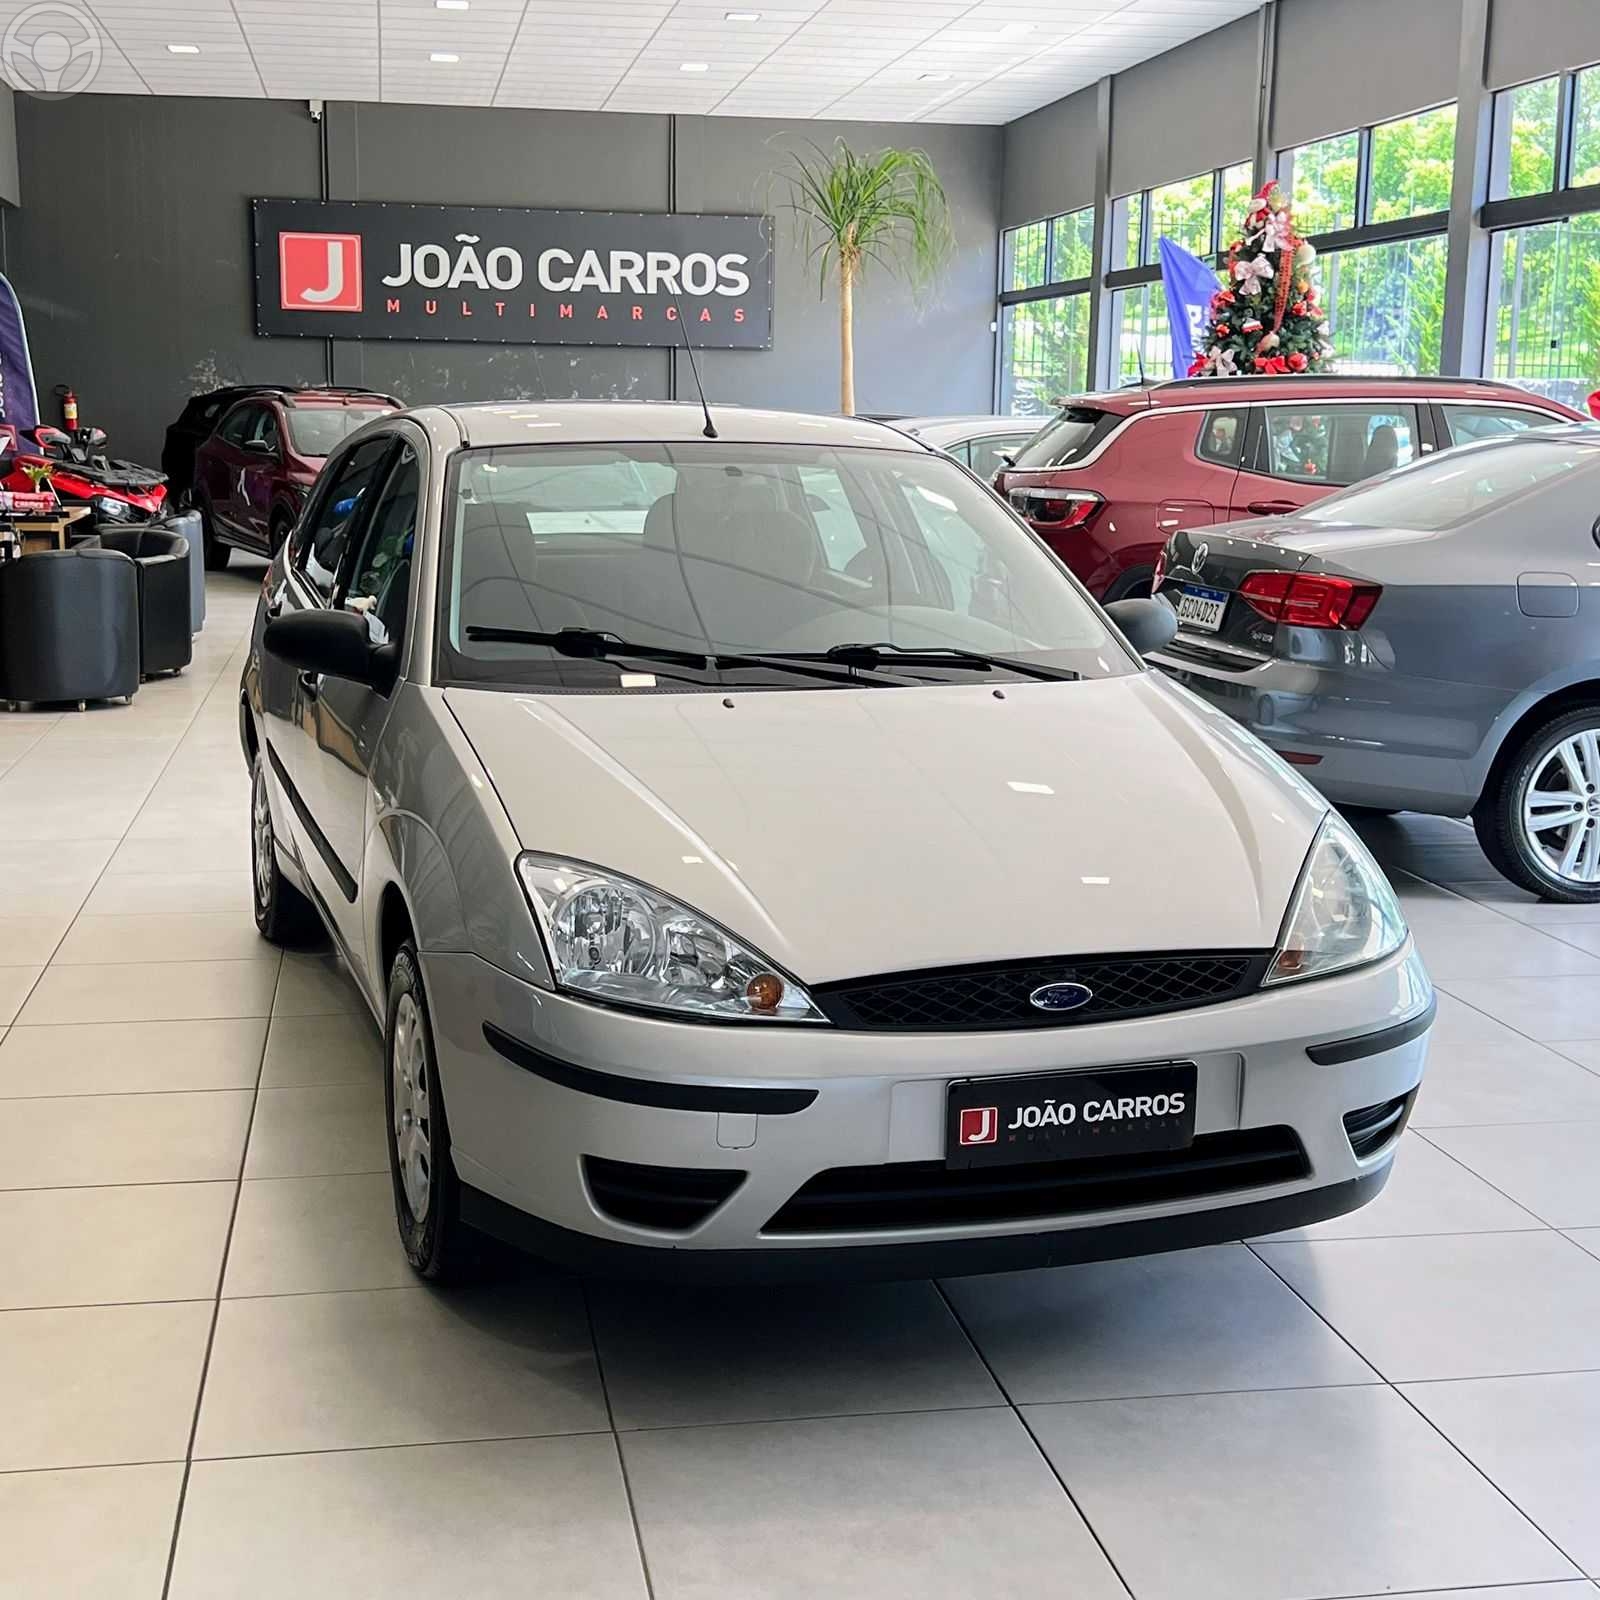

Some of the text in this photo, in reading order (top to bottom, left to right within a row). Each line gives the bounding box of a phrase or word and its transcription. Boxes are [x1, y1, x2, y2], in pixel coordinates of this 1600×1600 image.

[300, 241, 343, 303] J
[382, 233, 750, 297] JOÃO CARROS
[387, 299, 745, 323] MULTIMARCAS
[968, 1110, 990, 1141] J
[1008, 1092, 1185, 1129] JOÃO CARROS
